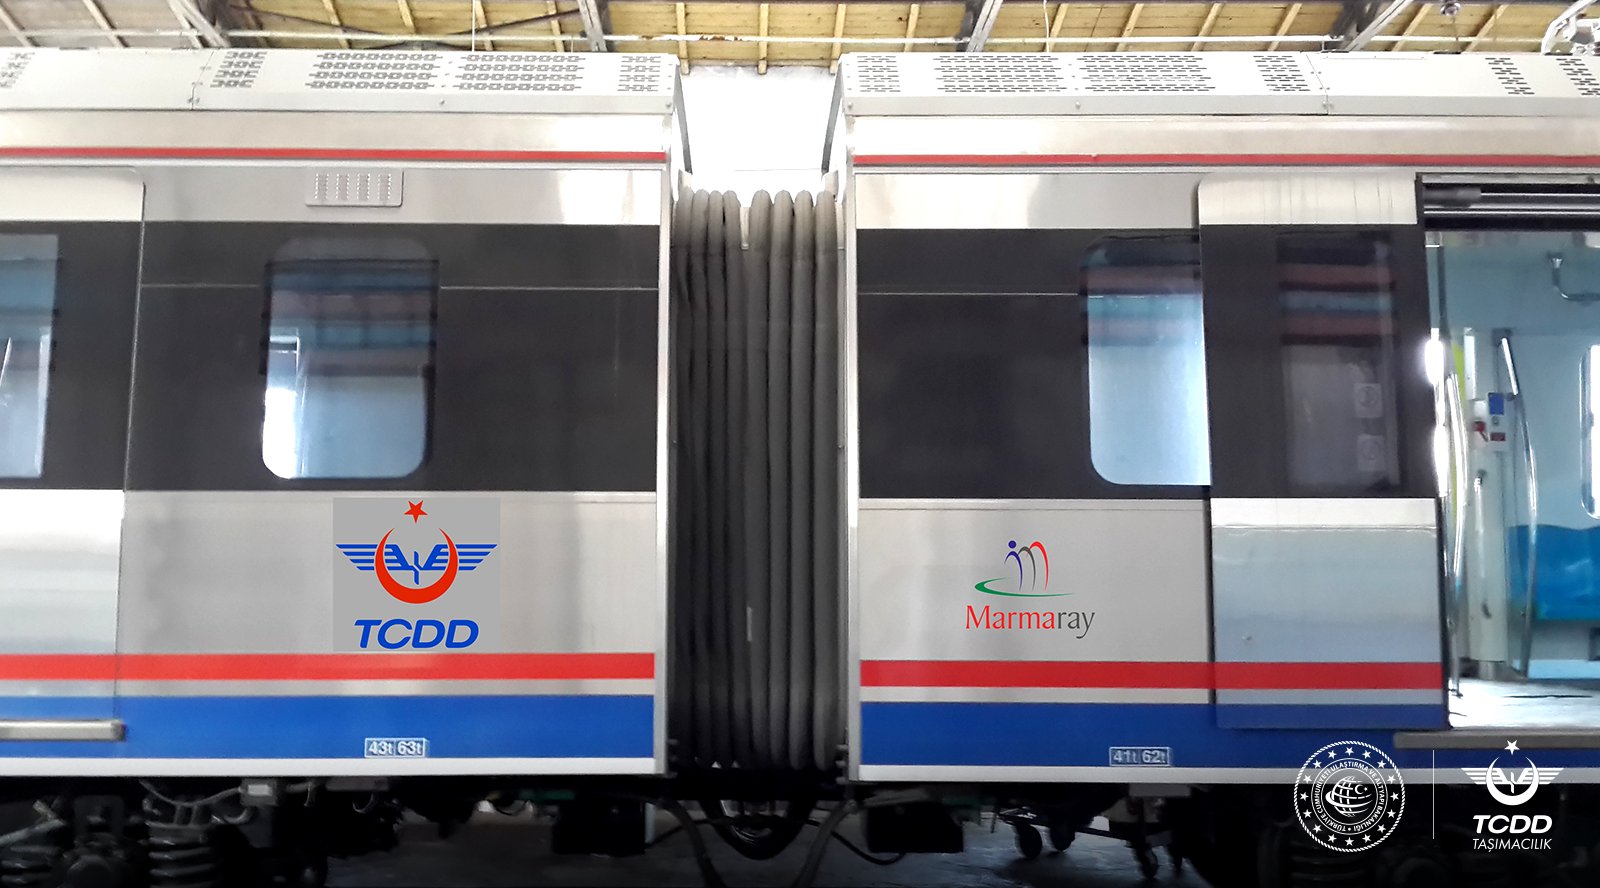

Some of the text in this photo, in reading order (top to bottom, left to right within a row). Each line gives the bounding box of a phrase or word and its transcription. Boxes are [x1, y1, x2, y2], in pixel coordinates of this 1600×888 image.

[354, 618, 479, 650] TCDD
[965, 605, 1096, 639] Marmaray
[368, 741, 422, 755] 43t 63t
